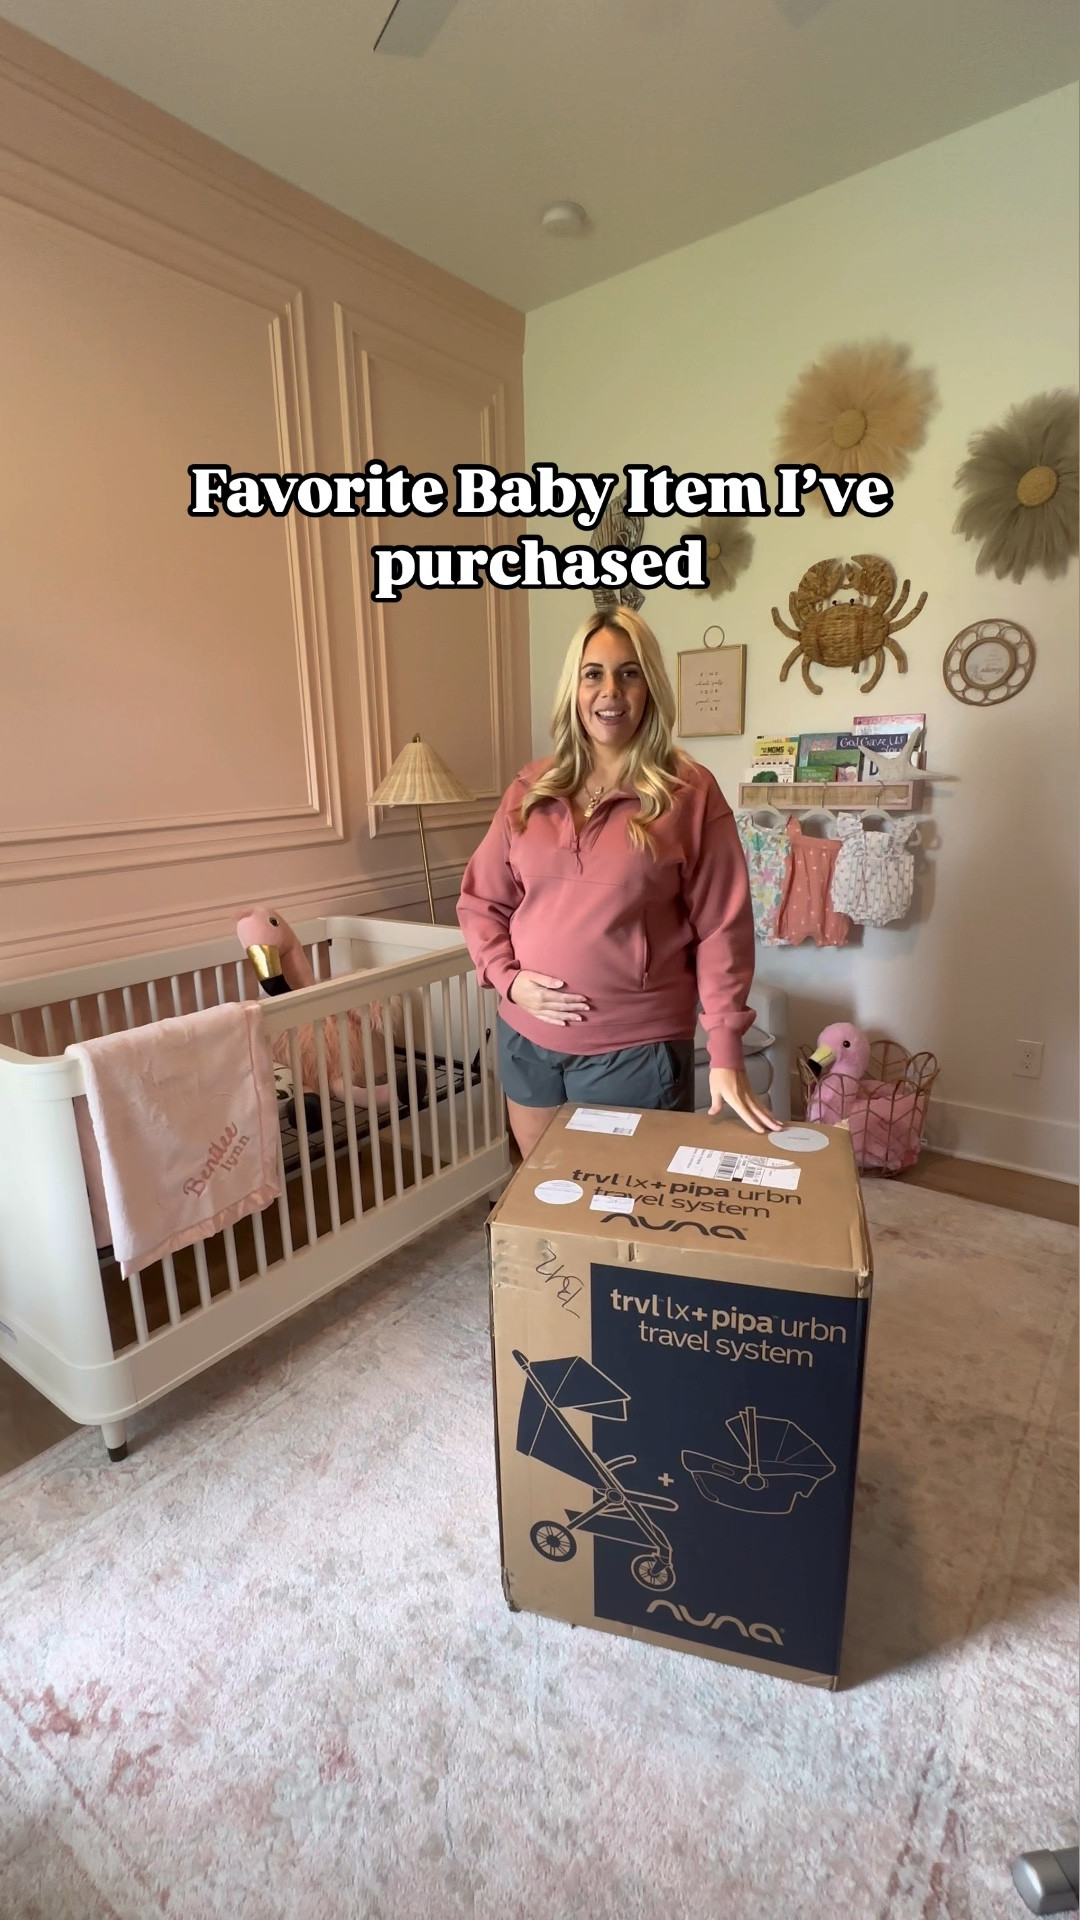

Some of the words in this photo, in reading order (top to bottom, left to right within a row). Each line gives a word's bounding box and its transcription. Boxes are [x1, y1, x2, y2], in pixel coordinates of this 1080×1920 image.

[860, 736, 888, 747] Gave
[572, 1169, 620, 1186] trvl
[669, 1181, 730, 1198] pipa
[737, 1188, 803, 1206] urbn
[600, 1212, 748, 1241] nuna
[671, 1198, 771, 1219] system
[609, 1288, 660, 1317] trvl
[711, 1306, 774, 1335] pipa
[780, 1316, 848, 1345] urbn
[638, 1320, 710, 1353] travel
[715, 1338, 814, 1369] system
[646, 1599, 786, 1646] nuna
